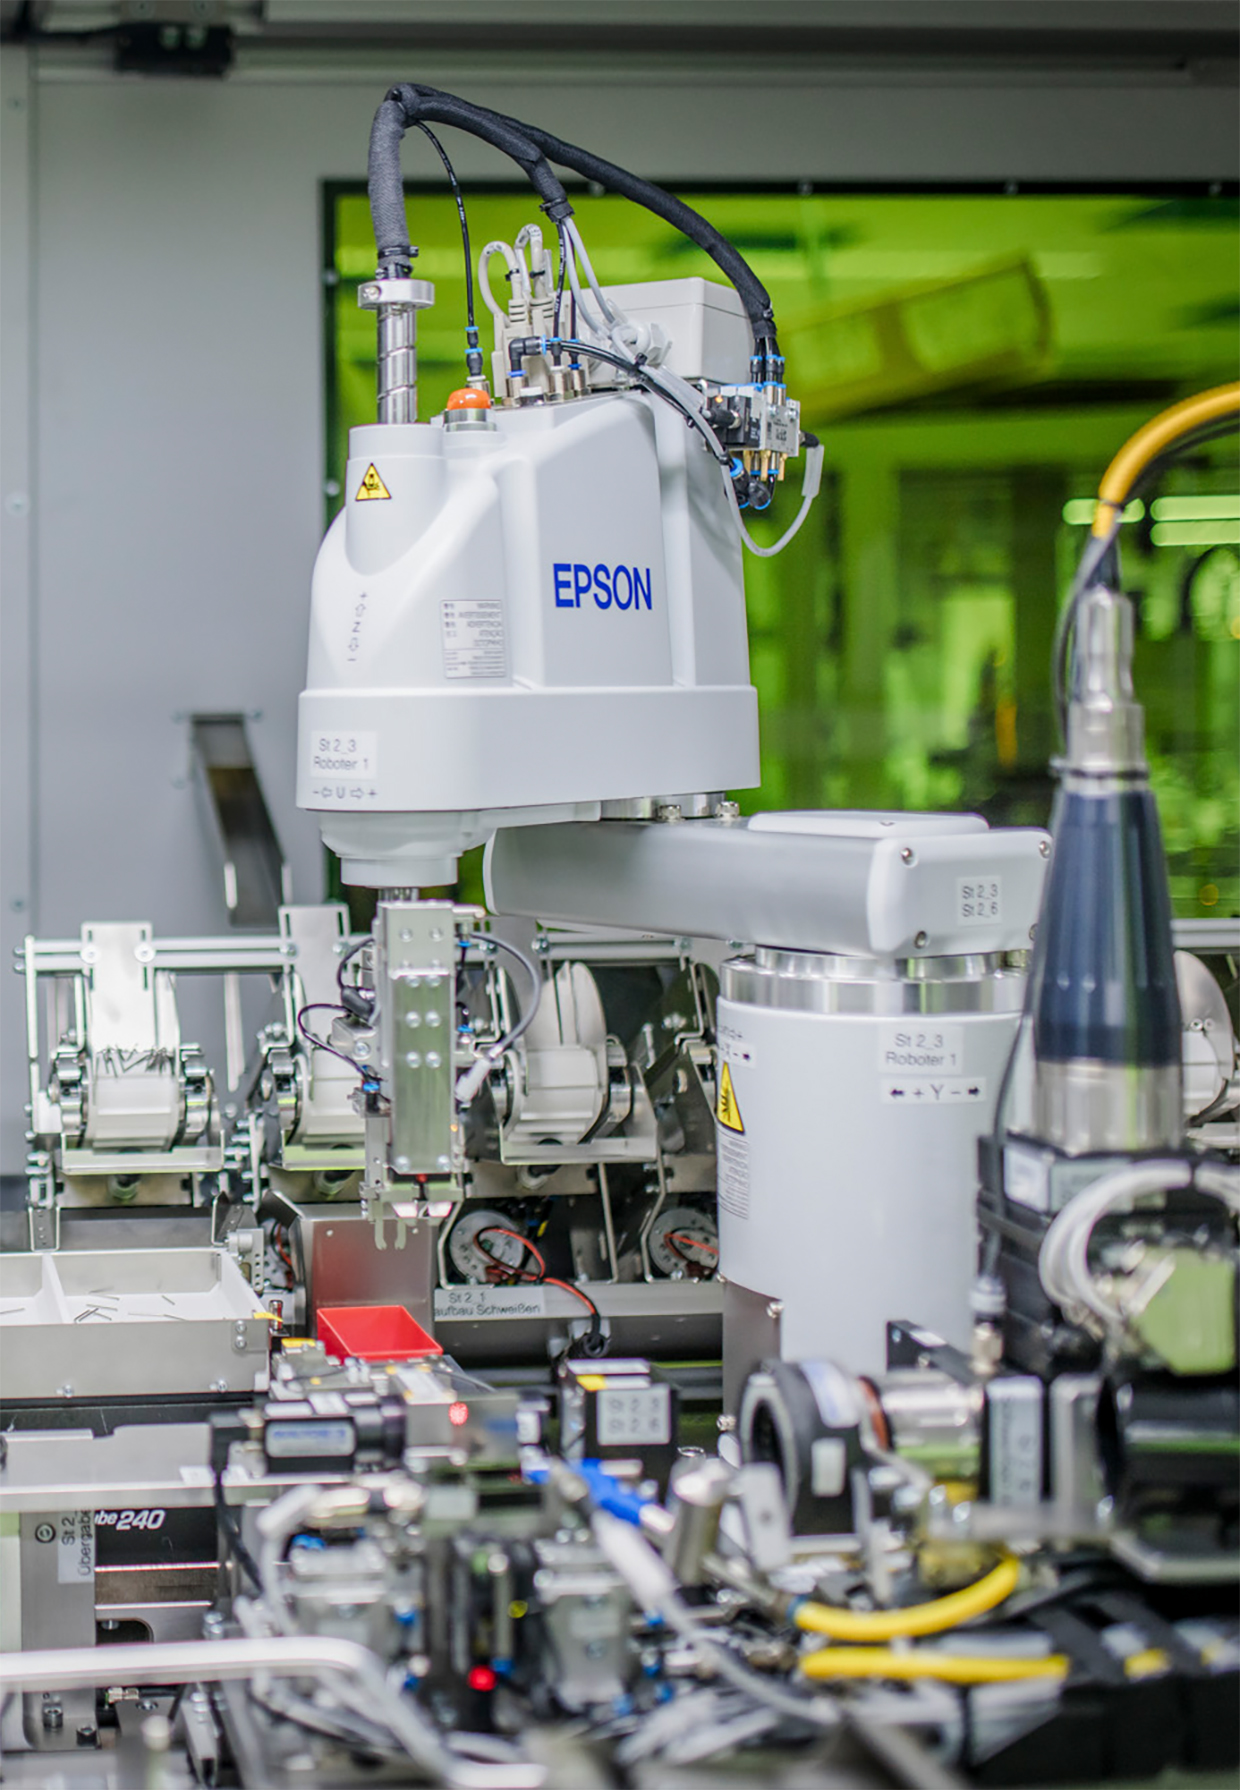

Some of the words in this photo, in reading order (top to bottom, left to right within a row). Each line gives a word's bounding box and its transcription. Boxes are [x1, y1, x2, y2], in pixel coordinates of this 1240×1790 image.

[552, 563, 652, 610] EPSON
[313, 755, 358, 770] Roboter
[894, 1033, 912, 1048] St
[885, 1051, 944, 1066] Roboter
[930, 1084, 944, 1101] Y
